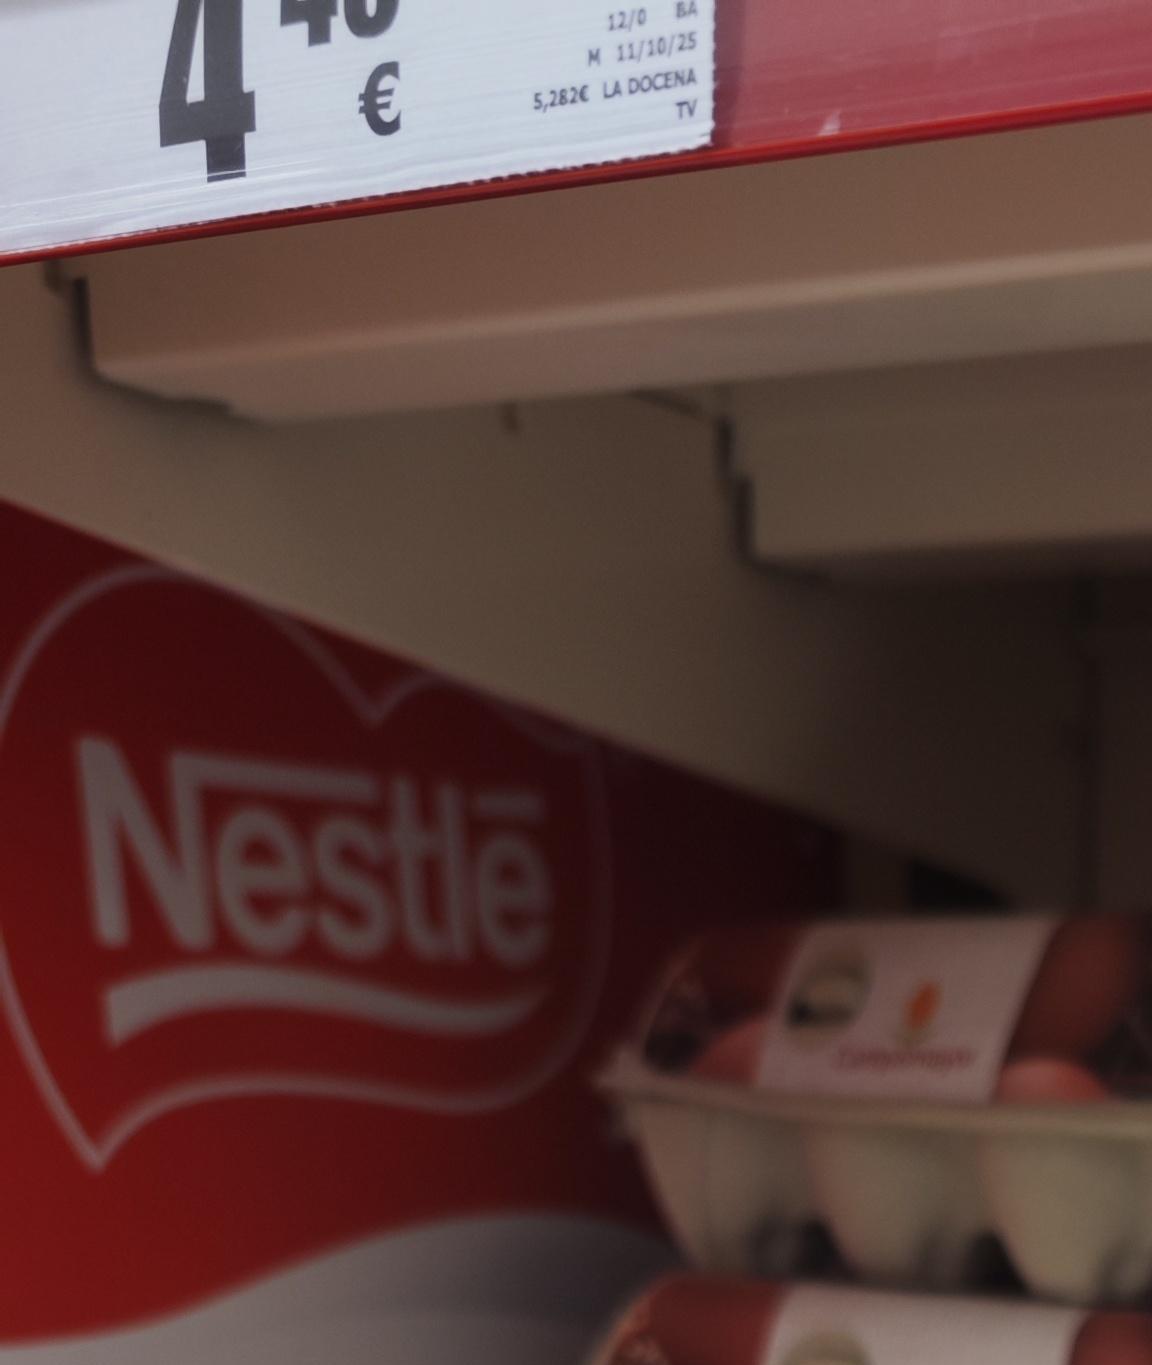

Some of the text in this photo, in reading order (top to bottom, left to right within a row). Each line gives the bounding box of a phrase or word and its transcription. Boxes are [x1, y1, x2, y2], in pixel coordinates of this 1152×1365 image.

[588, 31, 697, 66] M 11/10/25
[159, 0, 256, 182] 4
[358, 61, 400, 136] €
[533, 68, 697, 112] 5,282€ LA DOCENA
[676, 99, 697, 119] TV
